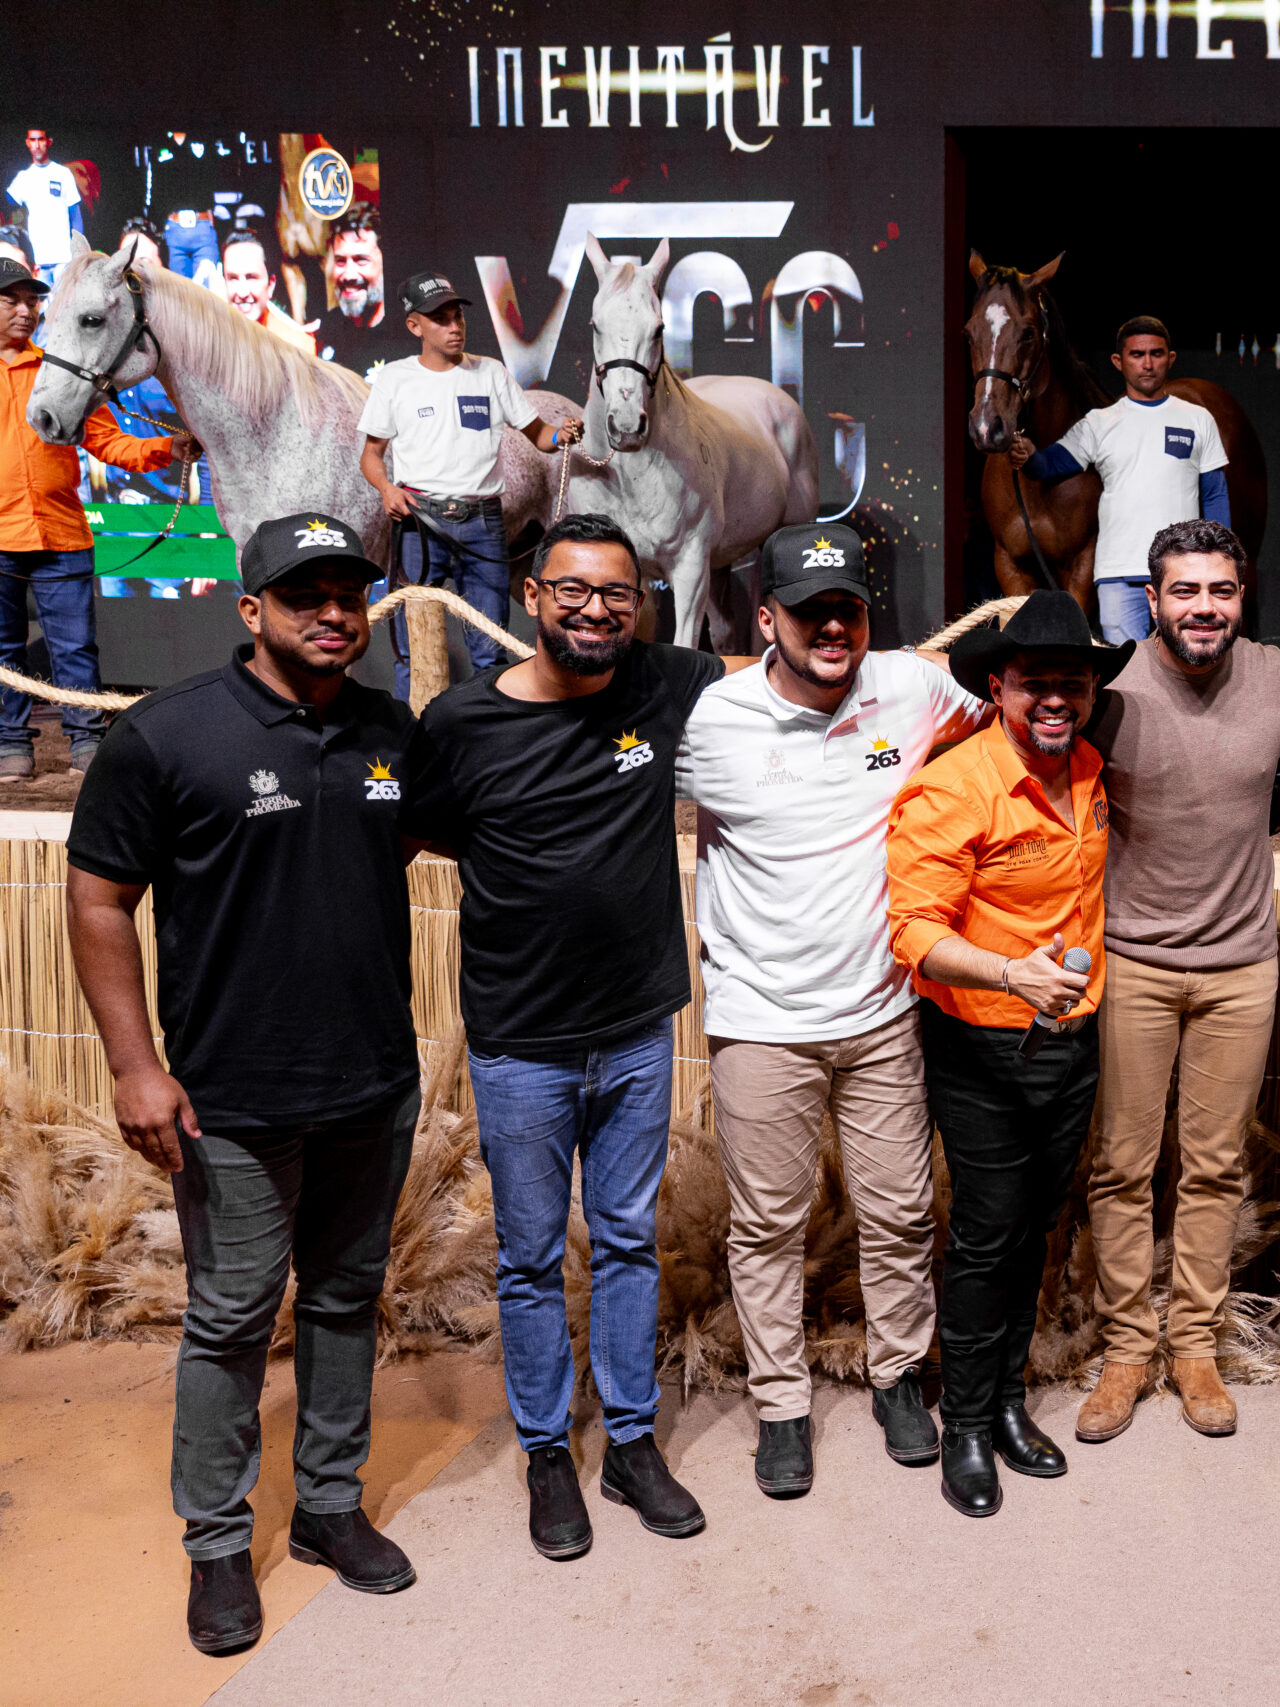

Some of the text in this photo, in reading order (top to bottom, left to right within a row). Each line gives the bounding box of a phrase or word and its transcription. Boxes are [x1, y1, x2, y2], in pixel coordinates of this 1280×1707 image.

[467, 32, 875, 152] INEVITÁVEL
[294, 529, 348, 549] 263
[802, 548, 846, 569] 263
[614, 742, 654, 773] 263
[865, 748, 902, 771] 263
[364, 779, 401, 800] 263
[244, 799, 302, 818] PROMETIDA
[251, 794, 291, 809] TERRA
